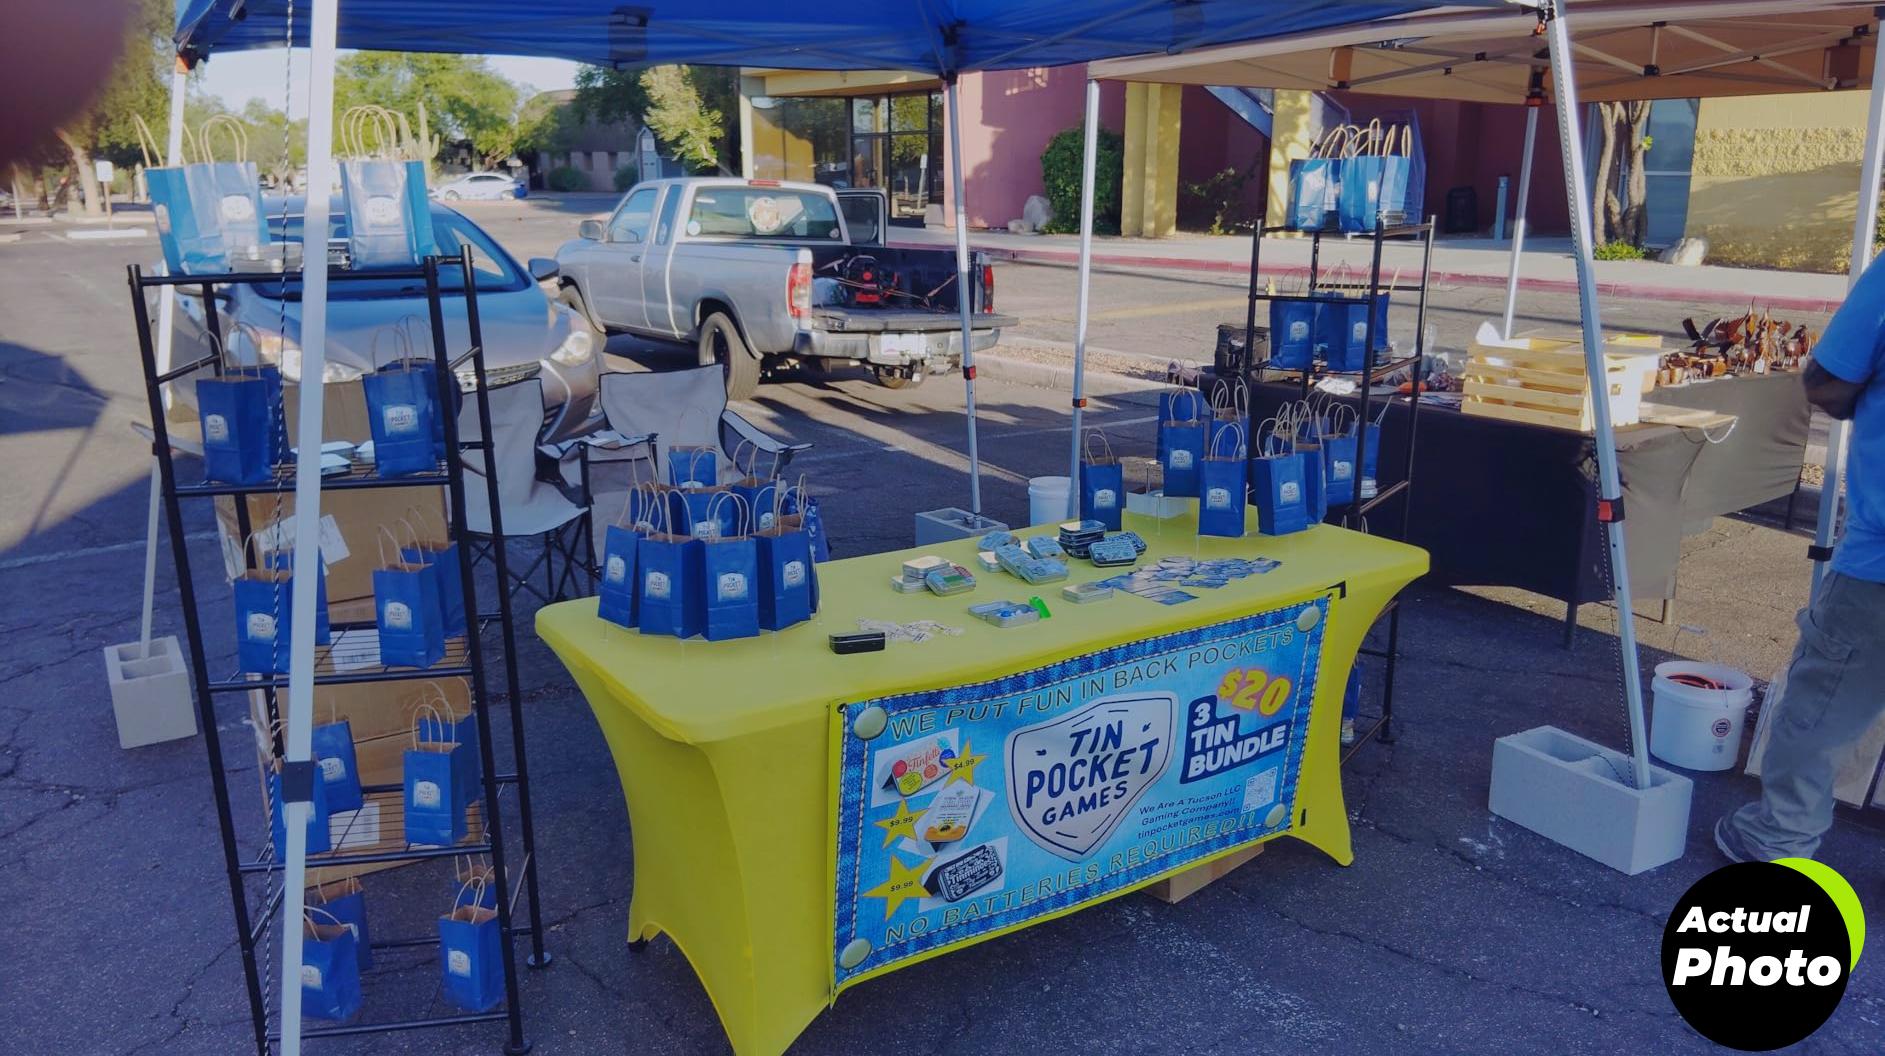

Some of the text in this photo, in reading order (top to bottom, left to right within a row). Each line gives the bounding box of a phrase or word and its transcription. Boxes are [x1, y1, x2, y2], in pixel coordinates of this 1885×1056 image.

[891, 626, 1294, 740] WE PUT FUN IN BACK POCKETS
[1218, 668, 1291, 716] $20
[1193, 702, 1211, 727] 3
[1070, 720, 1123, 757] TIN
[1187, 724, 1287, 779] BUNDLE
[1191, 720, 1236, 752] TIN
[954, 758, 975, 770] $4.99
[1026, 738, 1159, 808] POCKET
[1042, 781, 1128, 826] GAMES
[1140, 806, 1155, 815] We
[1158, 801, 1175, 809] Are
[1187, 792, 1222, 805] Tucson
[1224, 784, 1241, 796] LLC
[1141, 797, 1236, 826] Gaming Company!!
[889, 816, 913, 827] $9.99
[1137, 807, 1240, 840] tinpocketgames.com
[885, 916, 929, 943] NO
[942, 861, 1099, 925] BATTERIES
[890, 881, 913, 892] $9.99
